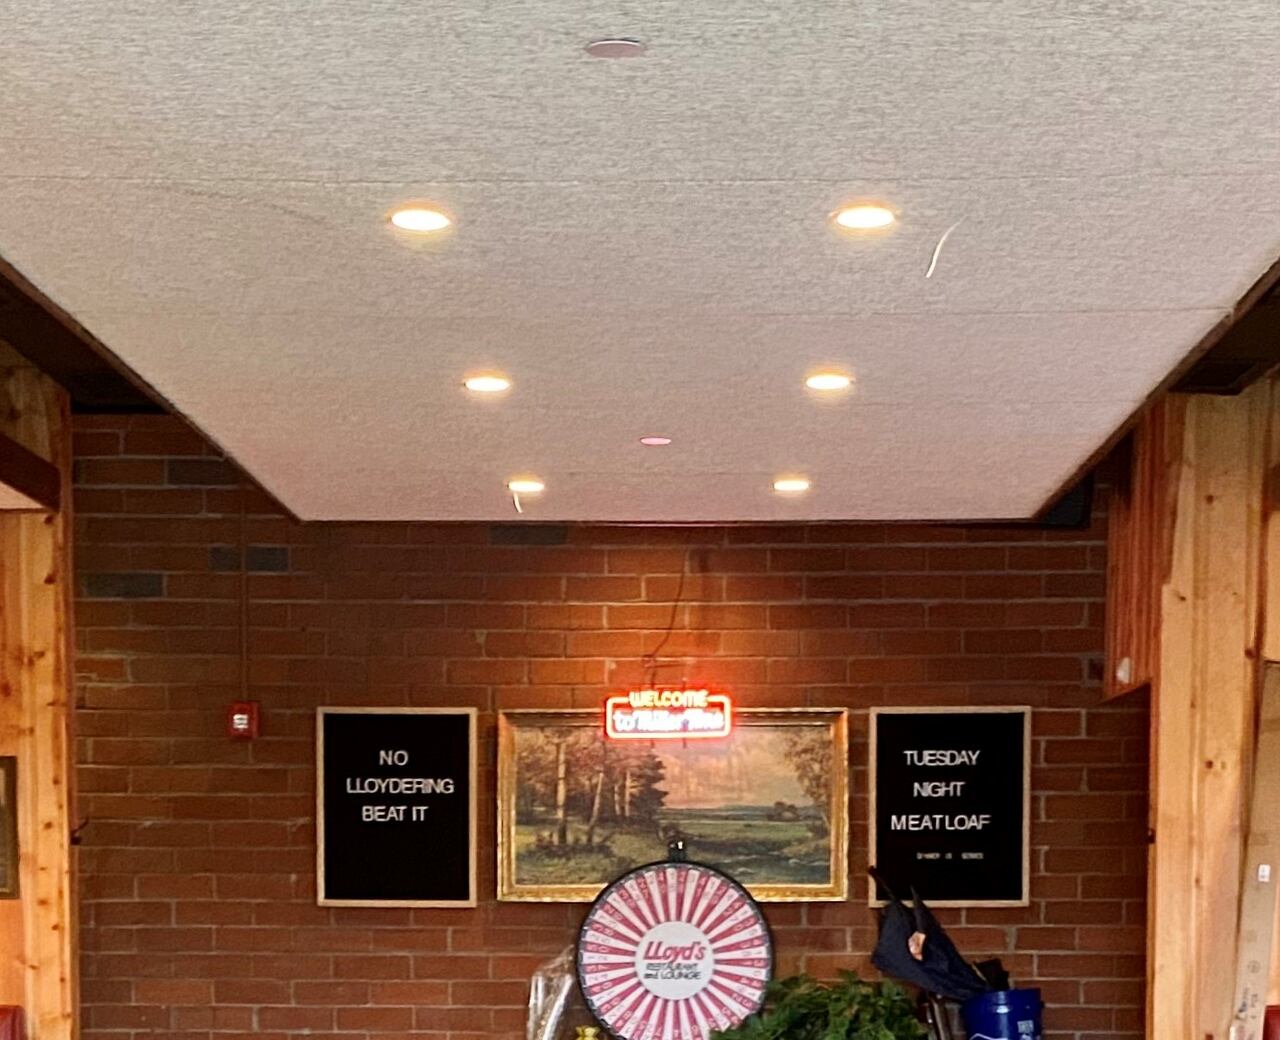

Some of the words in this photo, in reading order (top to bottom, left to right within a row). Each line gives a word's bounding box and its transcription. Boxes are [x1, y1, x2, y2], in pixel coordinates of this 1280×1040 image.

[629, 689, 708, 708] WELCOME
[379, 750, 409, 766] NO
[903, 750, 980, 766] TUESDAY
[346, 778, 455, 794] LLOYDERING
[913, 781, 966, 798] NIGHT
[362, 805, 407, 822] BEAT
[412, 805, 429, 822] IT
[890, 814, 992, 831] MEATLOAF
